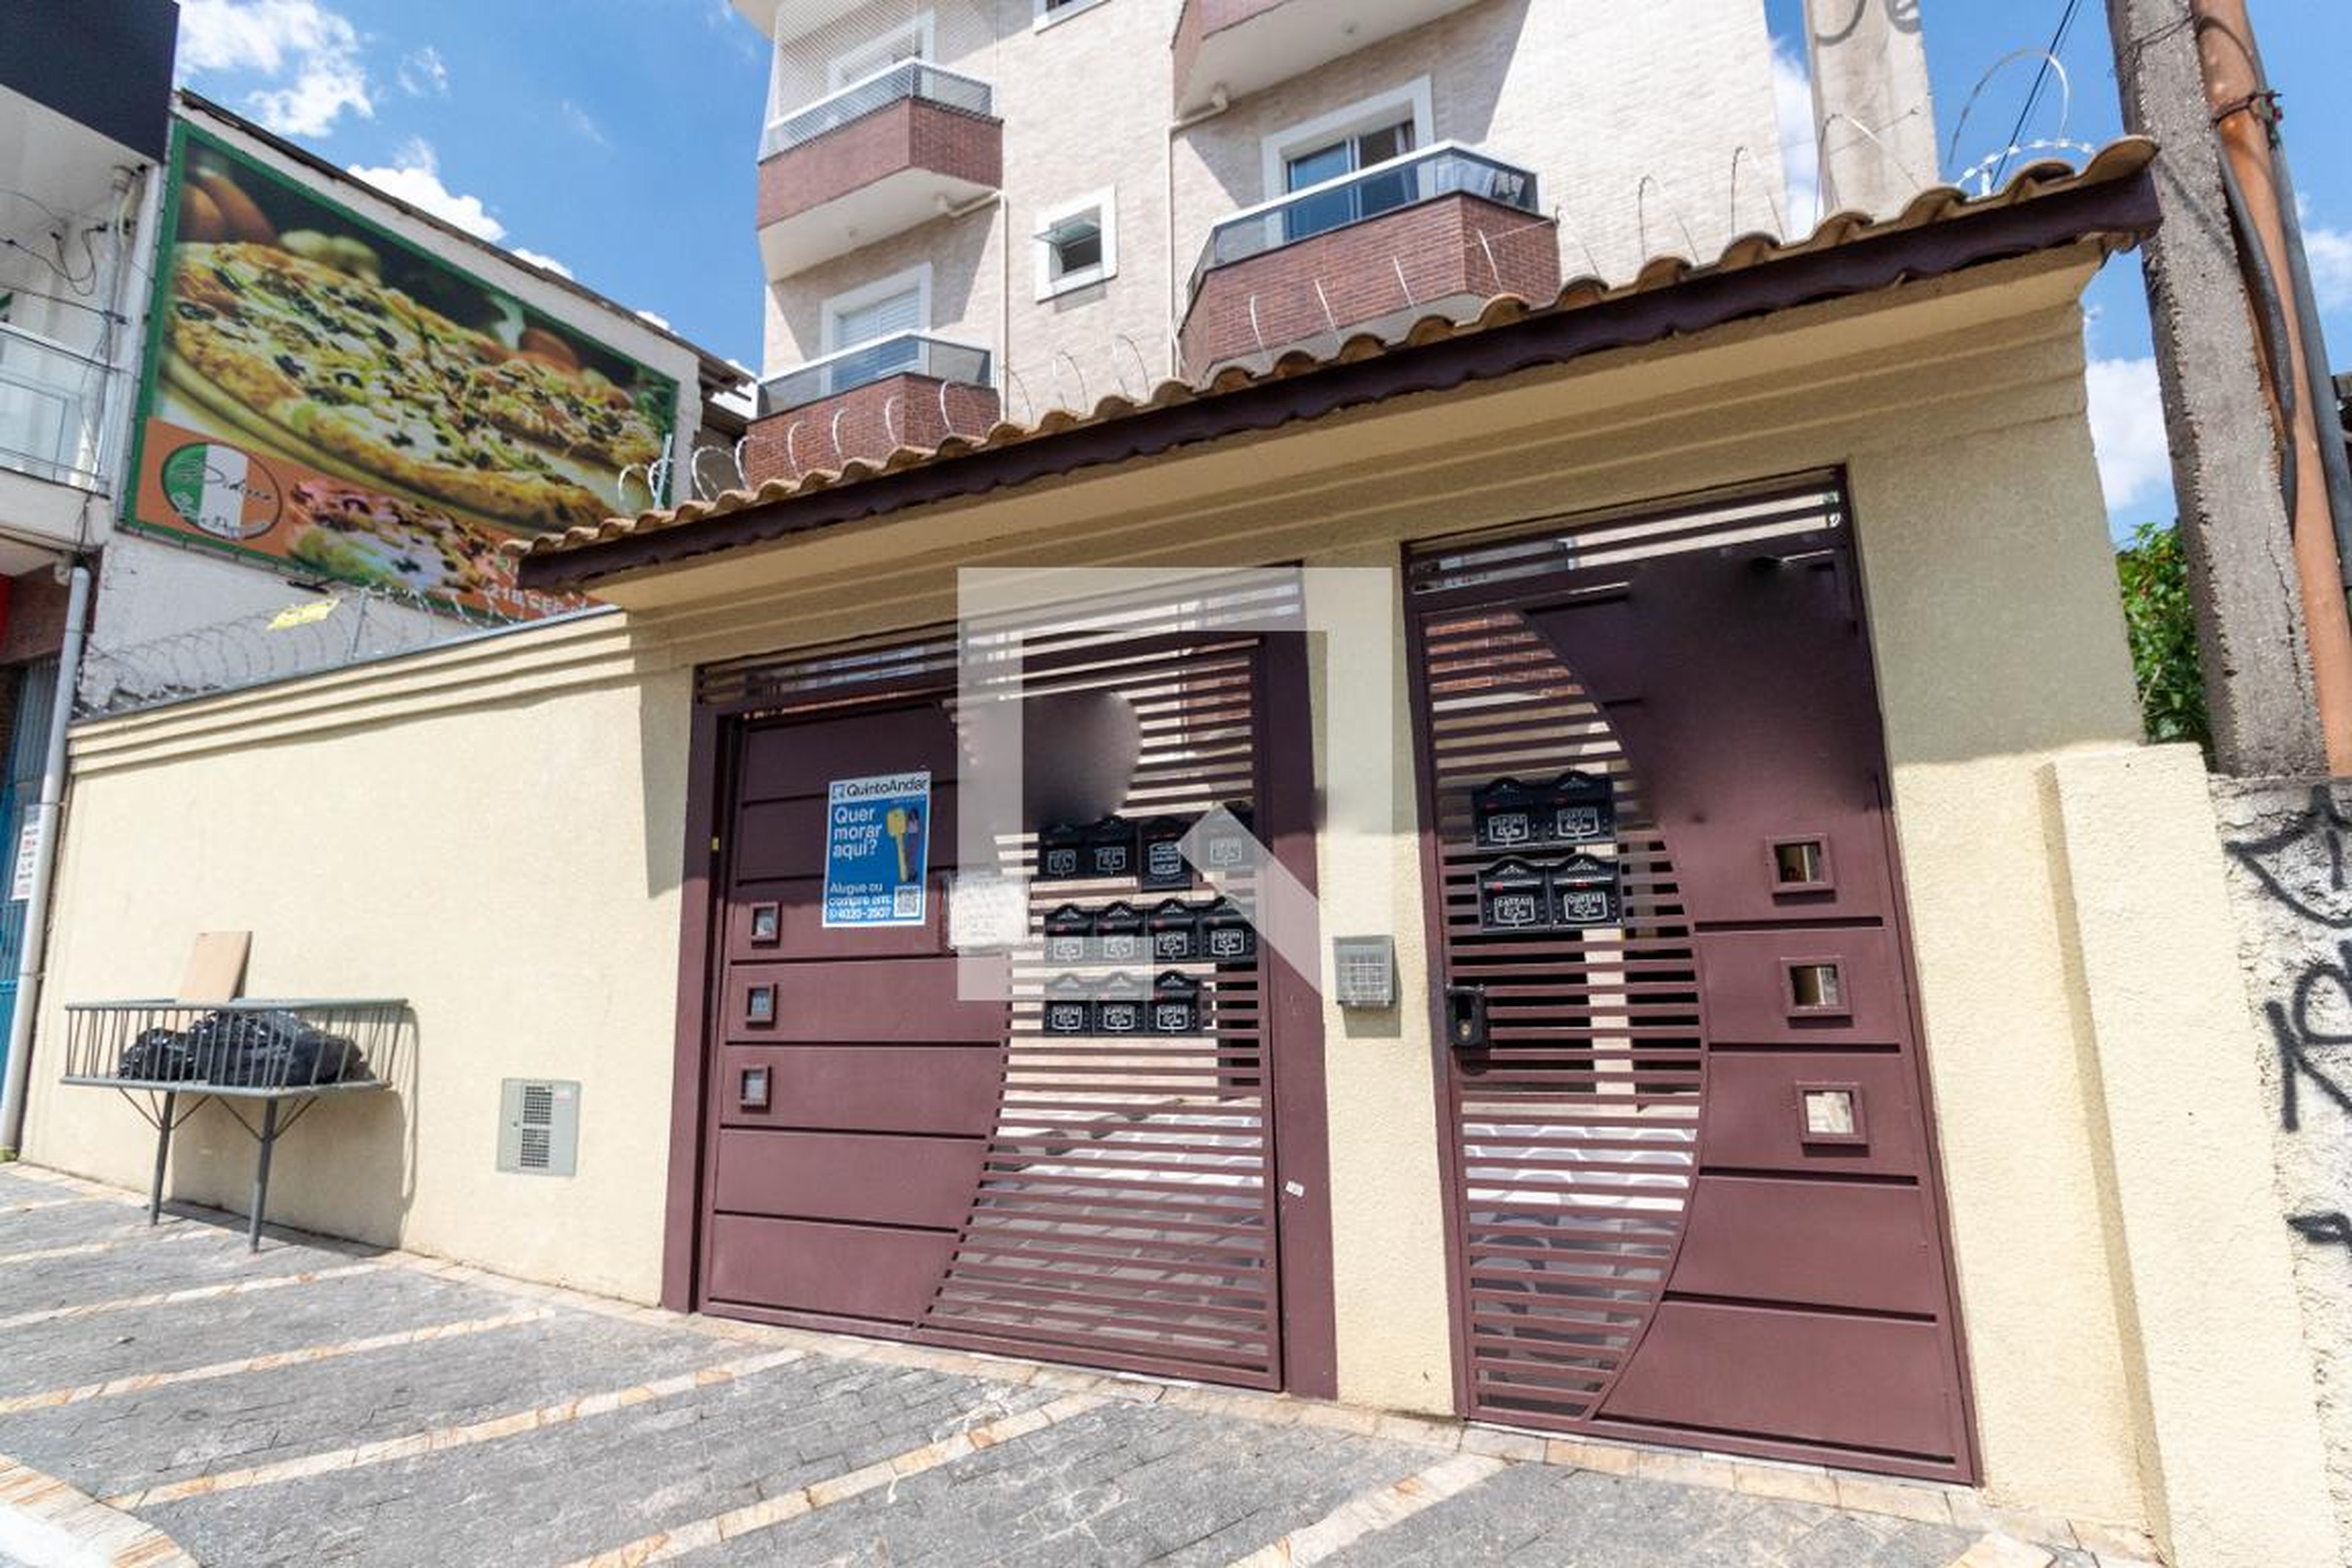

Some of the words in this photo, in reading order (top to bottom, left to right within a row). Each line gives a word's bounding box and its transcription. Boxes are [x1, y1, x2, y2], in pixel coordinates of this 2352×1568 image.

[846, 778, 927, 796] QuintoAndar
[834, 807, 875, 824] Quer
[834, 824, 883, 841] morar
[832, 839, 877, 860] aqui?
